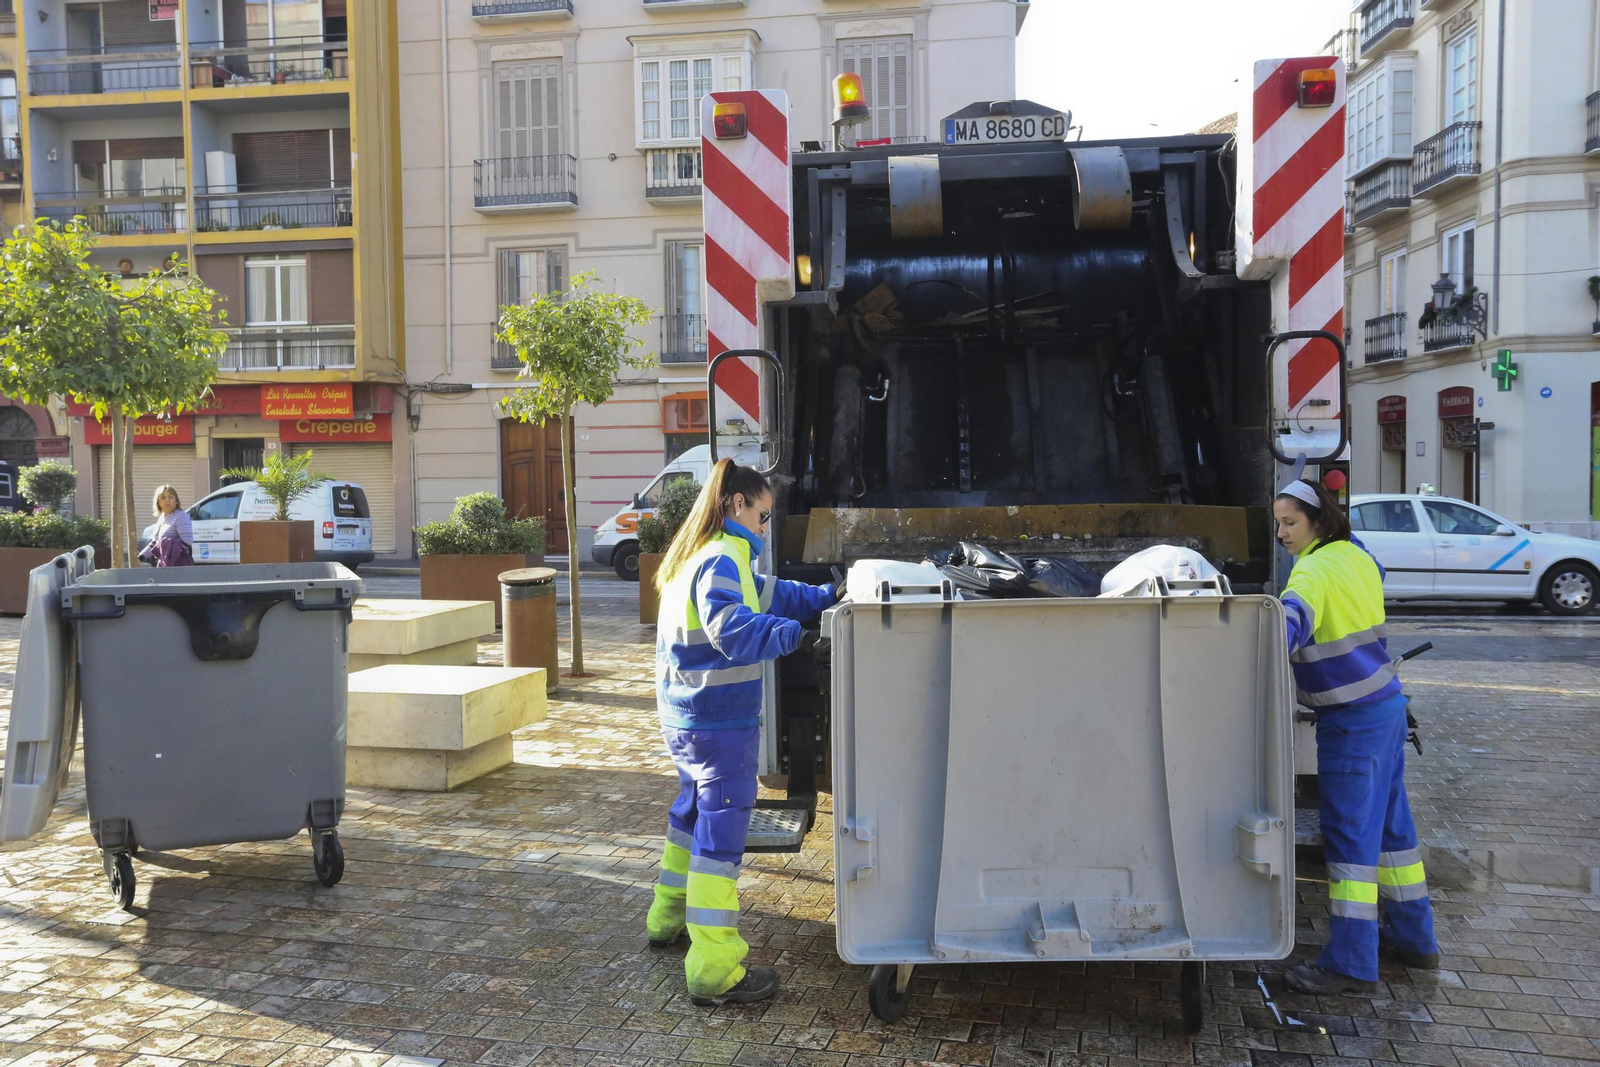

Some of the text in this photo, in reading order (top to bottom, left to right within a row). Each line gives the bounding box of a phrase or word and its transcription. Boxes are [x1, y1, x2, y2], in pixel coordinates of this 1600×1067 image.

[956, 116, 1065, 141] MA 8680 CD
[266, 388, 280, 399] Los
[265, 402, 350, 416] Ensaladas Showarmas
[101, 422, 179, 437] Hburger
